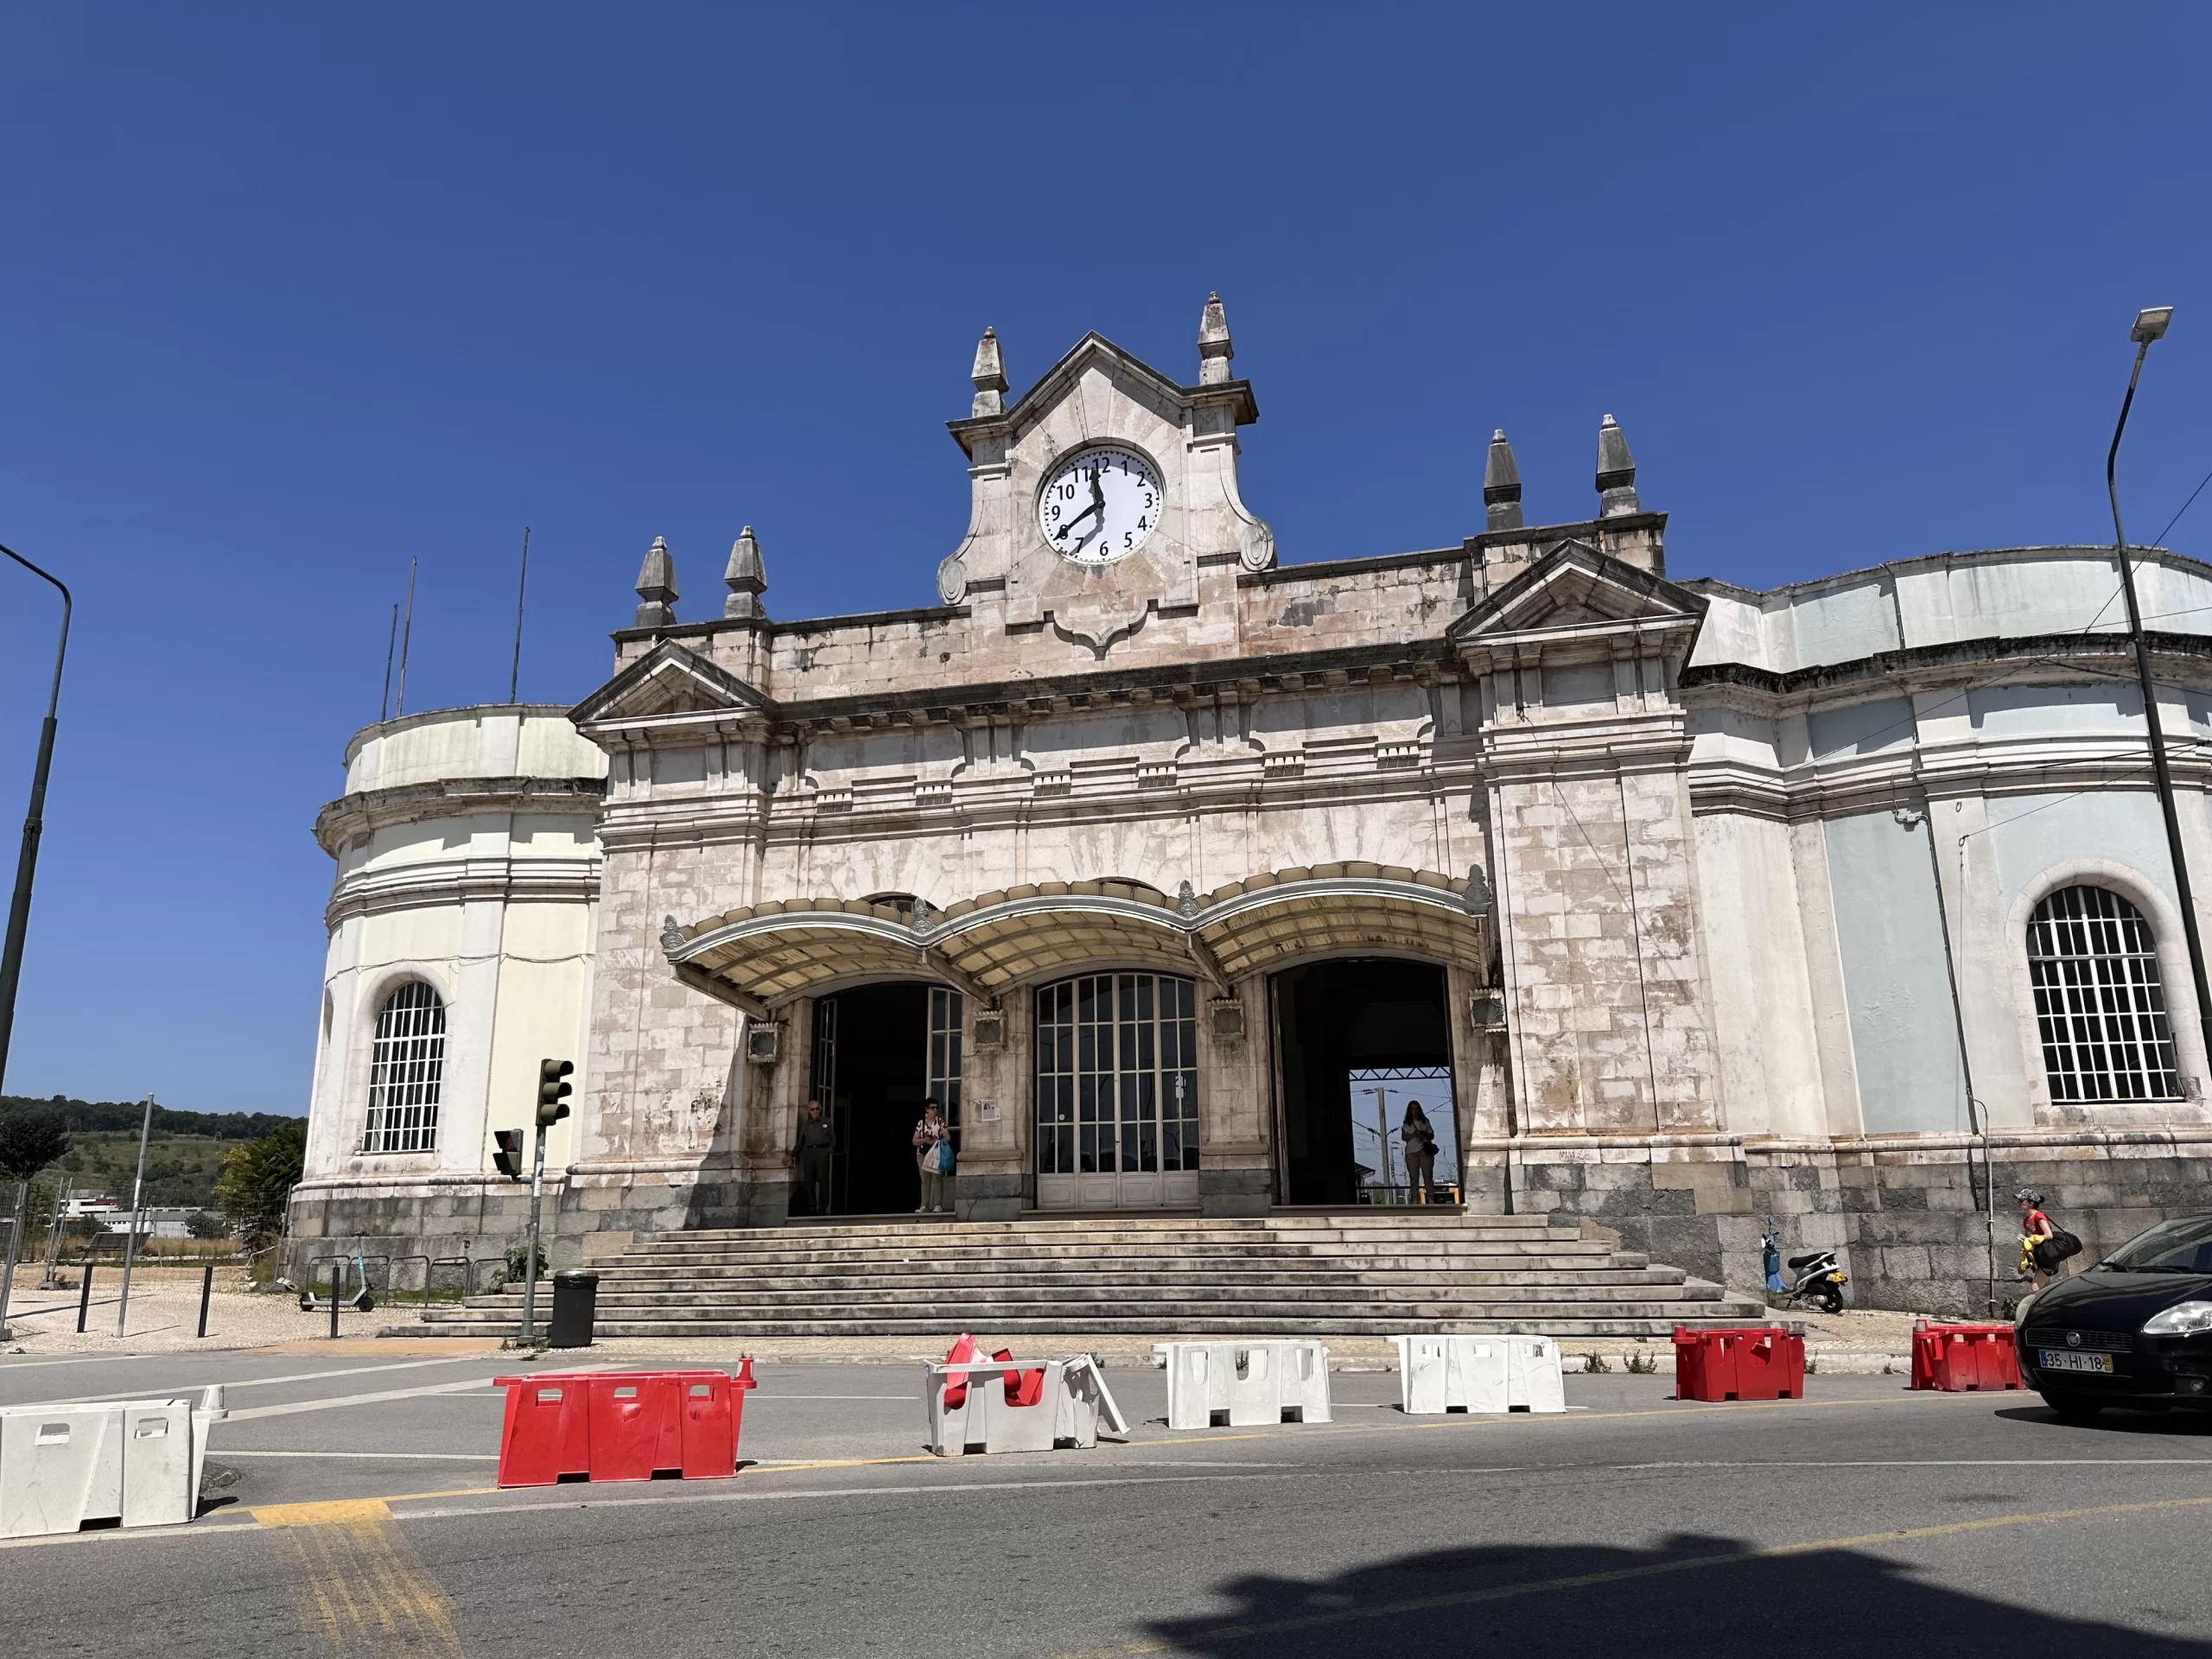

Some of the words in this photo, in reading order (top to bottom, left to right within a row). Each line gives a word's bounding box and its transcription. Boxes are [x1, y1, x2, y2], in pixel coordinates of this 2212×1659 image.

[1092, 457, 1110, 474] 12
[1121, 461, 1128, 476] 1
[1071, 466, 1089, 483] 11
[1137, 471, 1146, 487] 2
[1057, 484, 1075, 500] 10
[1144, 493, 1153, 509] 3
[1052, 505, 1061, 521] 9
[1137, 515, 1147, 531] 4
[1075, 537, 1084, 553] 7
[1124, 531, 1133, 548] 5
[1099, 541, 1109, 556] 6
